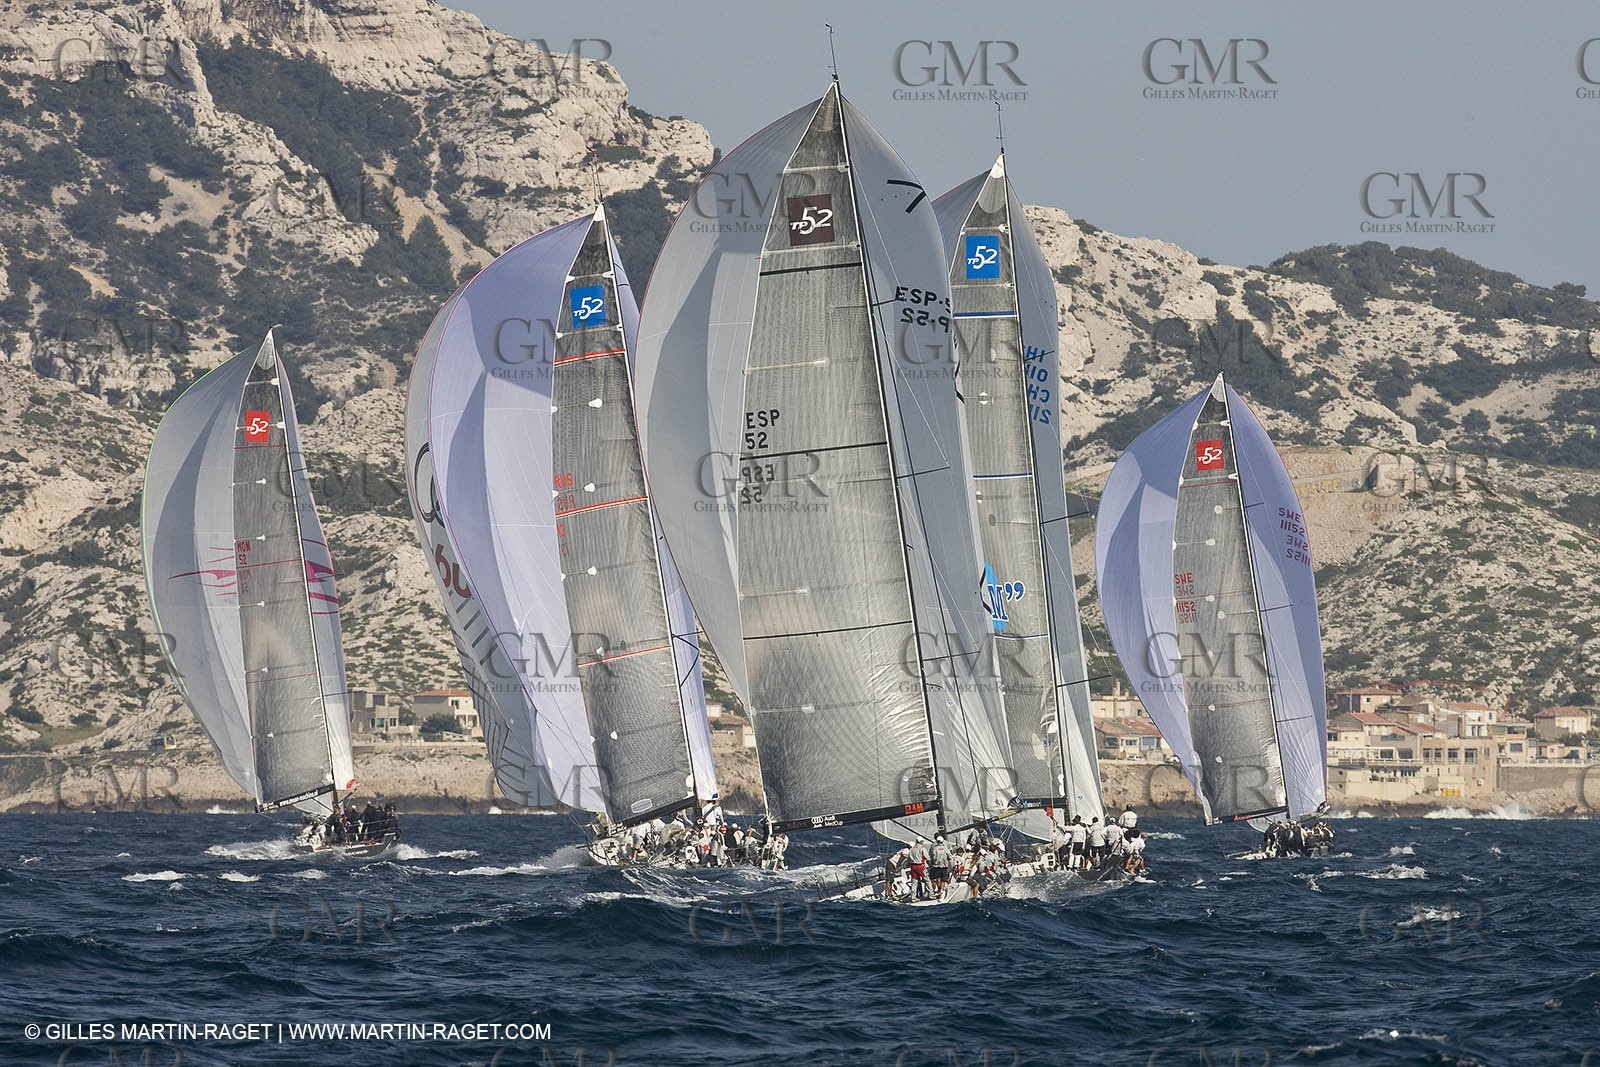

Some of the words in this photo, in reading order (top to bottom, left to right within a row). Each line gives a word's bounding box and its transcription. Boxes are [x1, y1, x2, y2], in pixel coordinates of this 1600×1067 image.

[745, 409, 780, 429] ESP
[745, 431, 769, 449] 52
[1278, 506, 1301, 523] SWE
[1280, 519, 1305, 537] 11152
[1174, 572, 1193, 584] SWE
